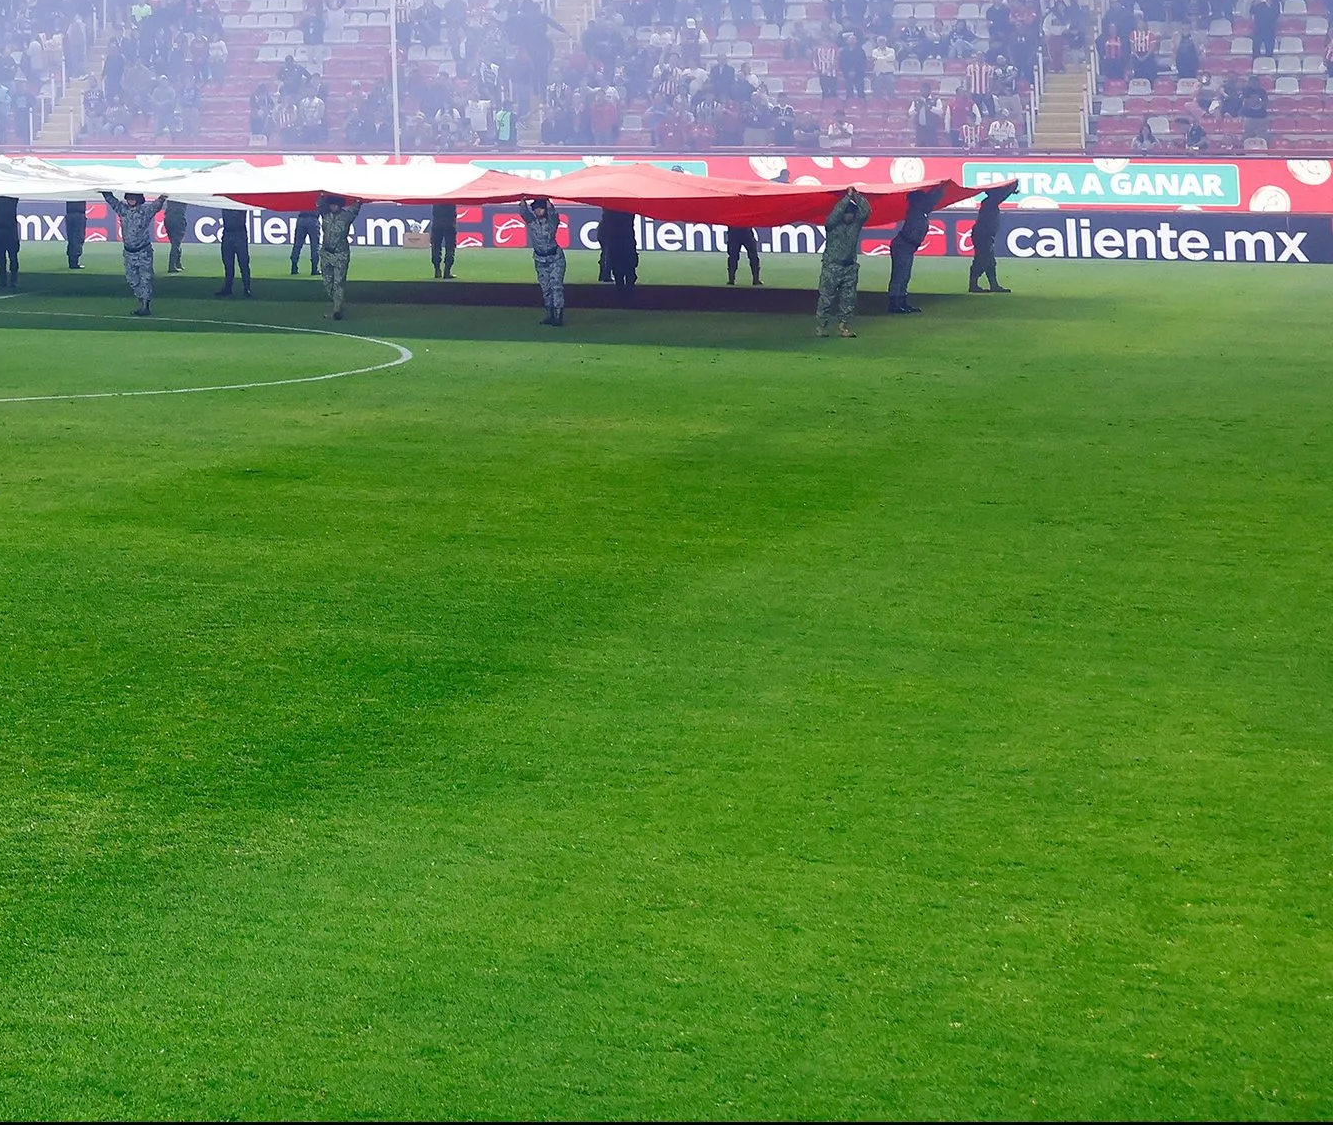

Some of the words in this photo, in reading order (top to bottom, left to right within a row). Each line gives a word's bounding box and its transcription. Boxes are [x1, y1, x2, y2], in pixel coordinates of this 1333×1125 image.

[1081, 173, 1105, 196] A
[1113, 172, 1225, 197] GANAR
[1006, 218, 1310, 264] caliente.mx
